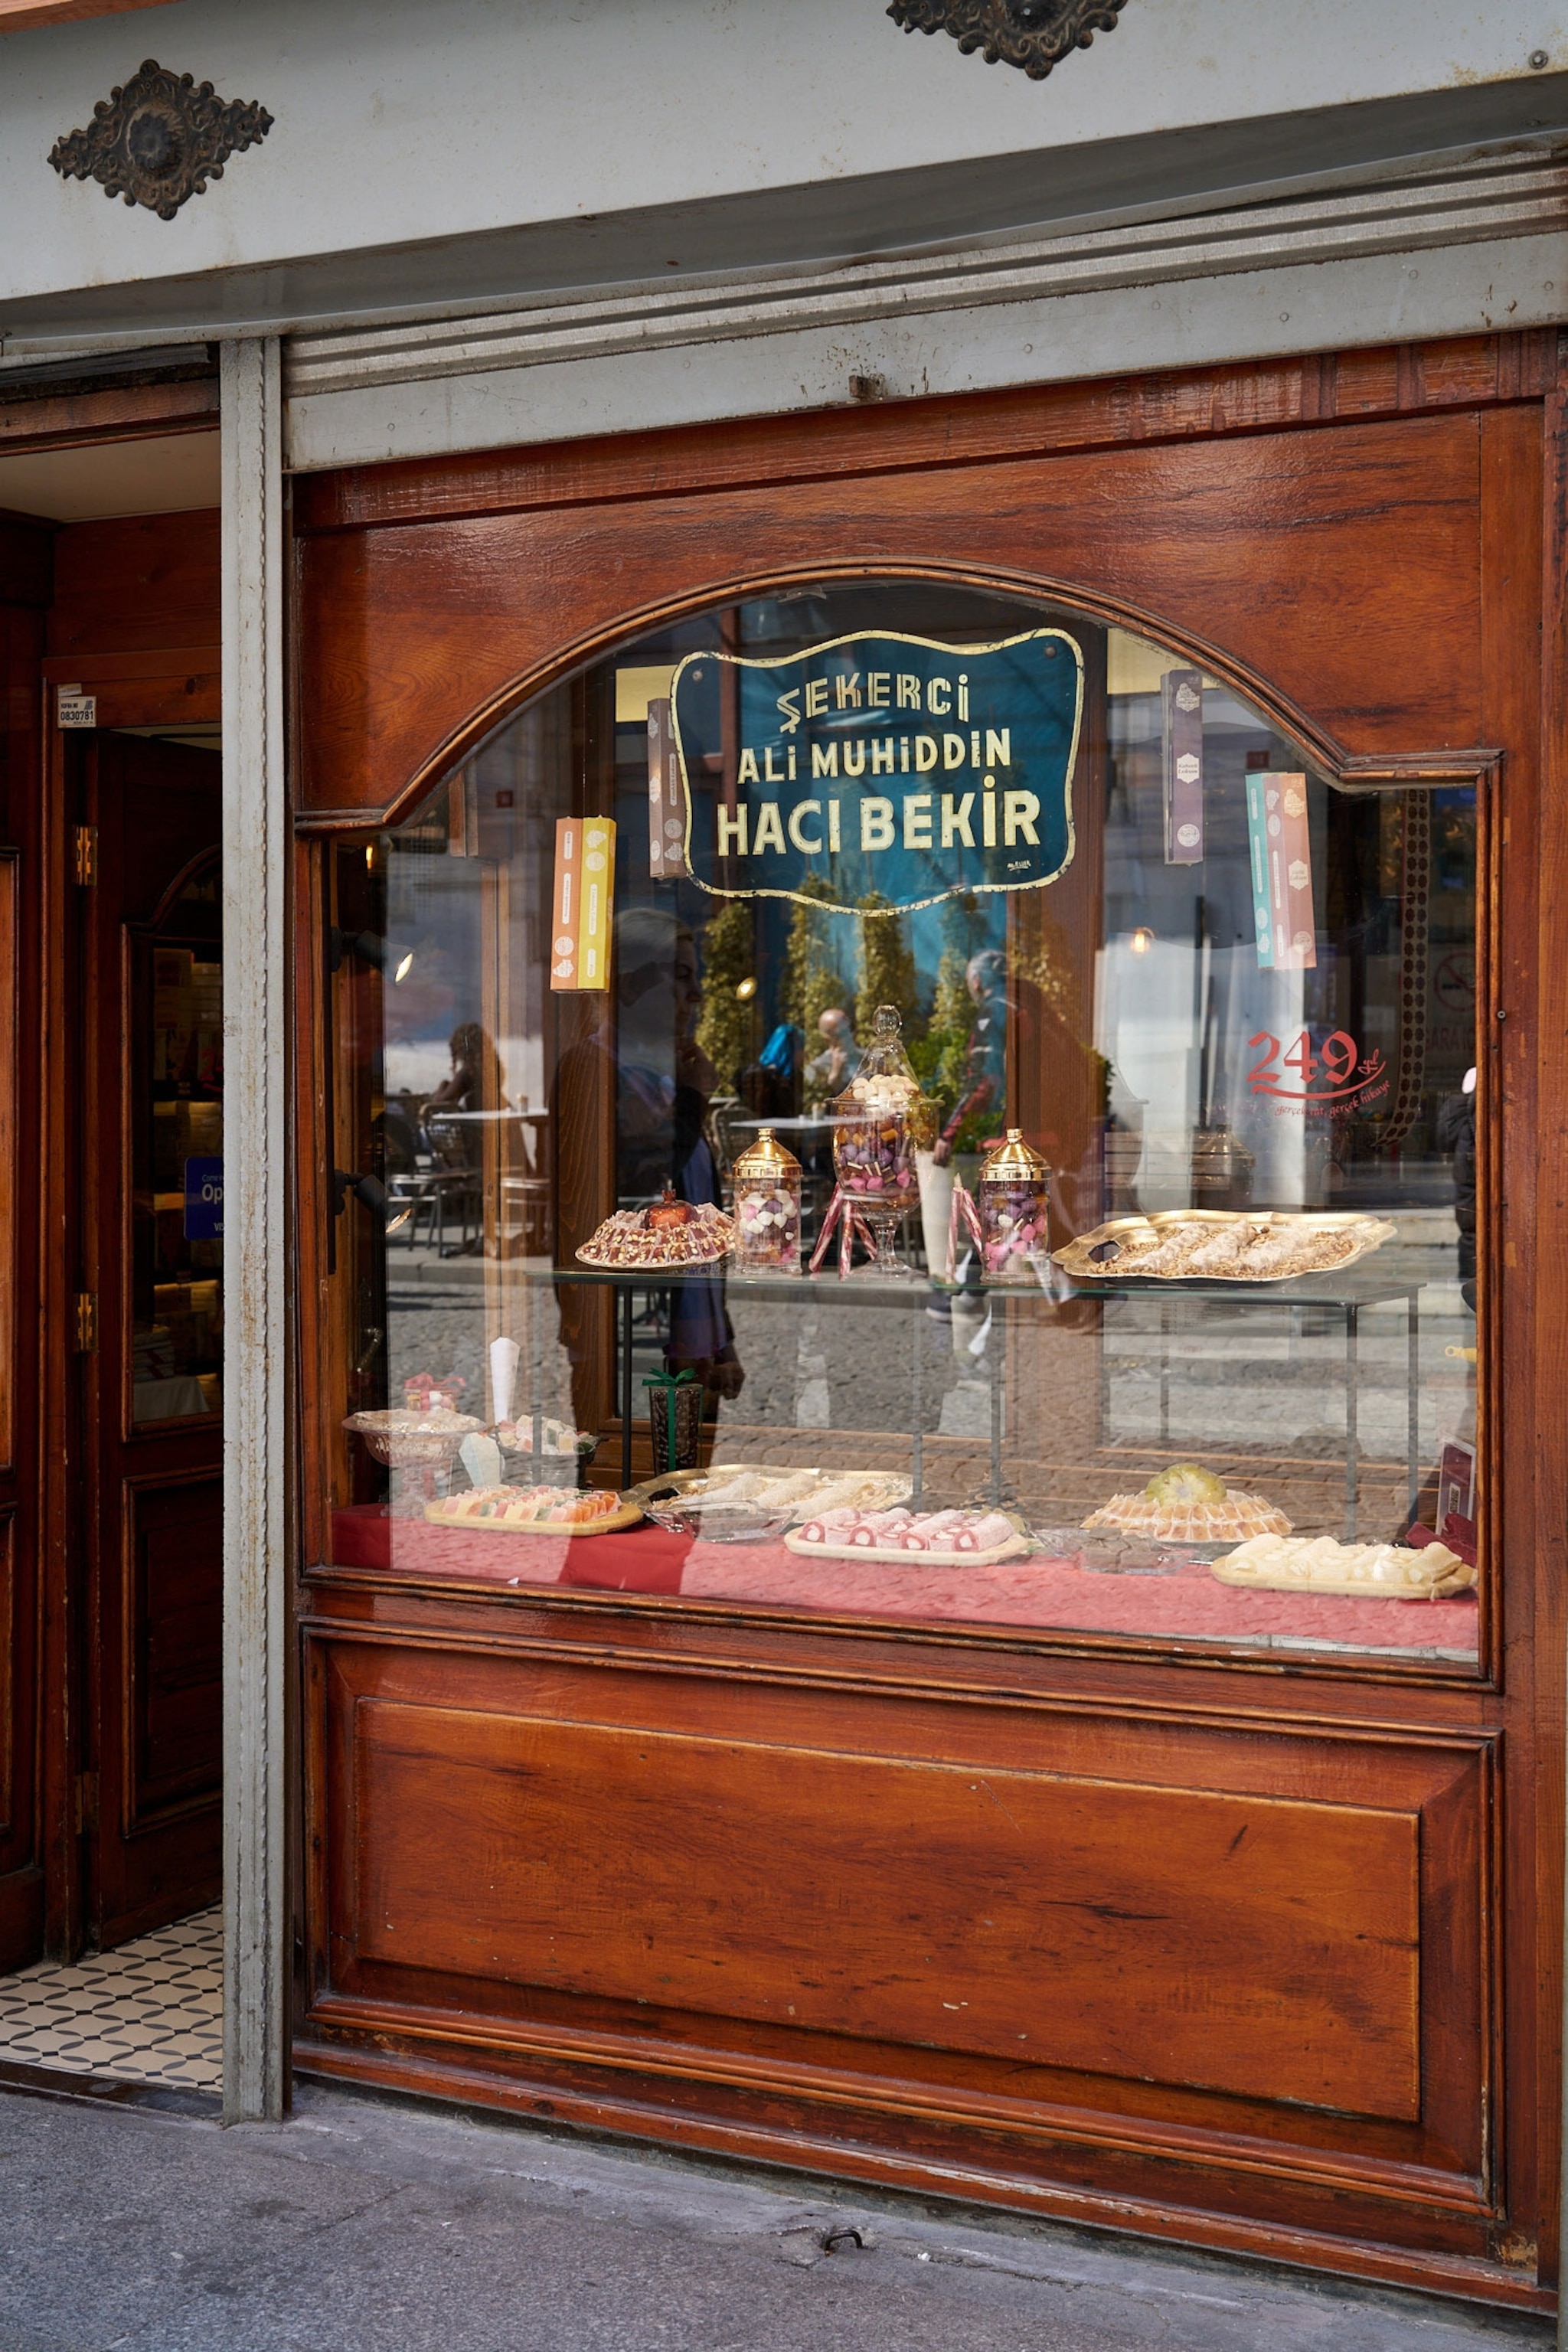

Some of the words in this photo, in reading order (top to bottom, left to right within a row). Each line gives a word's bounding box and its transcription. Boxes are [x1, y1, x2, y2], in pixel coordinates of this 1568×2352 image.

[60, 710, 94, 721] 0830781
[717, 799, 841, 857] HACI
[860, 774, 1041, 851] BEKİR
[1246, 1031, 1357, 1085] 249
[1328, 1095, 1360, 1119] gerçek
[1360, 1080, 1391, 1104] hikaye
[201, 1184, 224, 1205] Op
